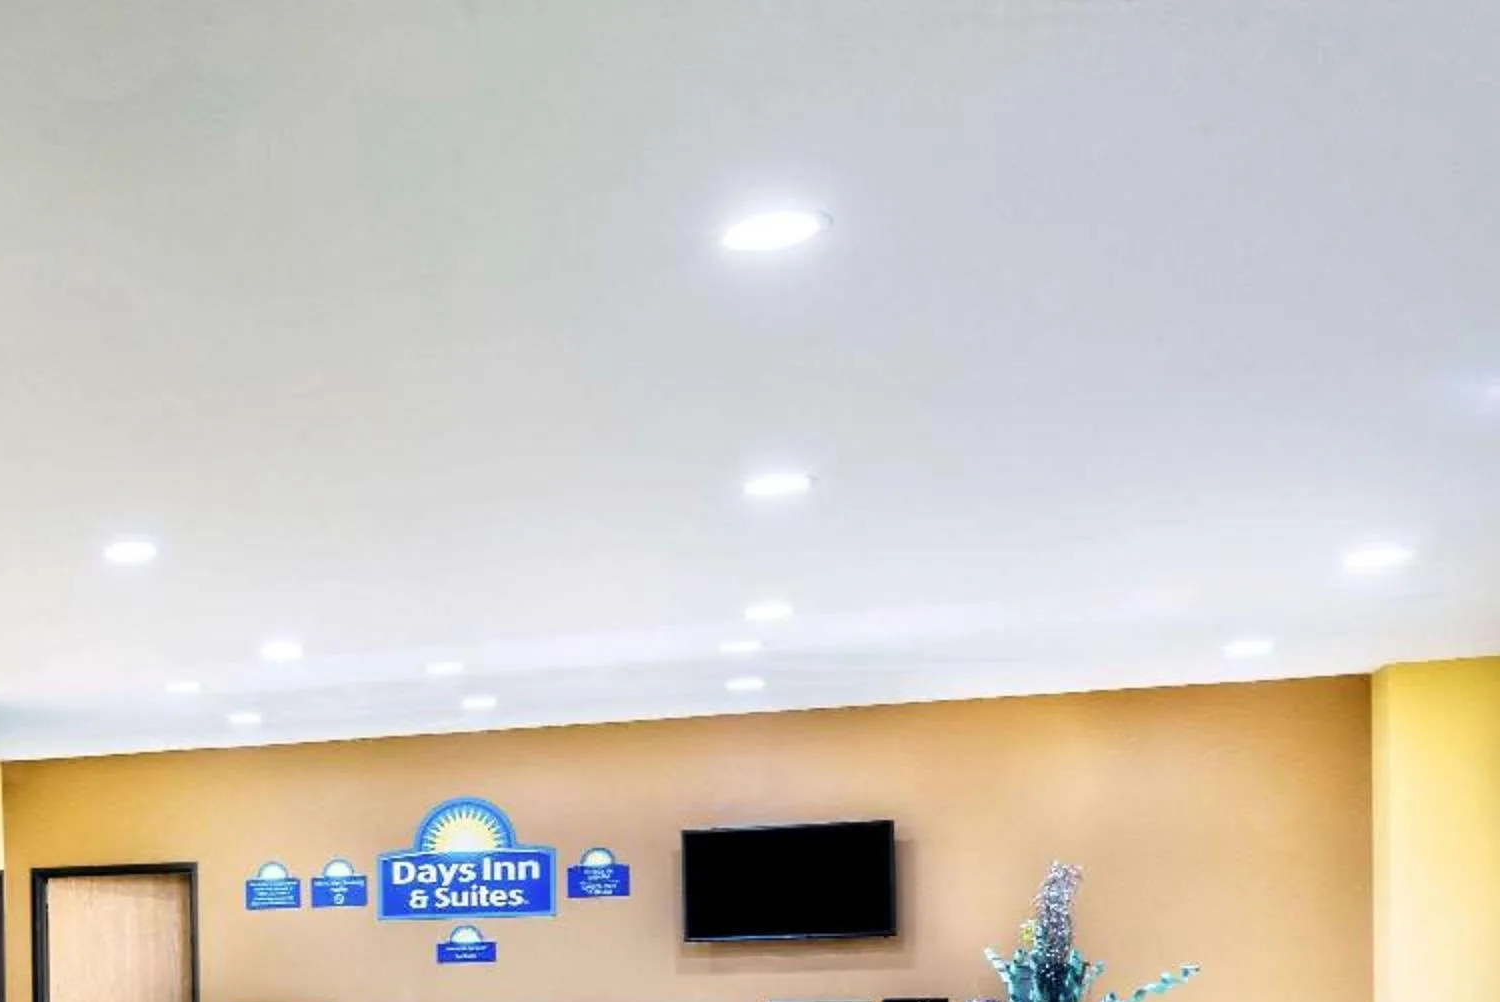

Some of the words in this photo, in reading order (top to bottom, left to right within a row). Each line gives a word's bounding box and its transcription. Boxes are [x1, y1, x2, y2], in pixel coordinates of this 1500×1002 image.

[391, 861, 477, 886] Days
[482, 857, 541, 881] Inn
[409, 889, 429, 909] &
[434, 884, 525, 908] Suites
